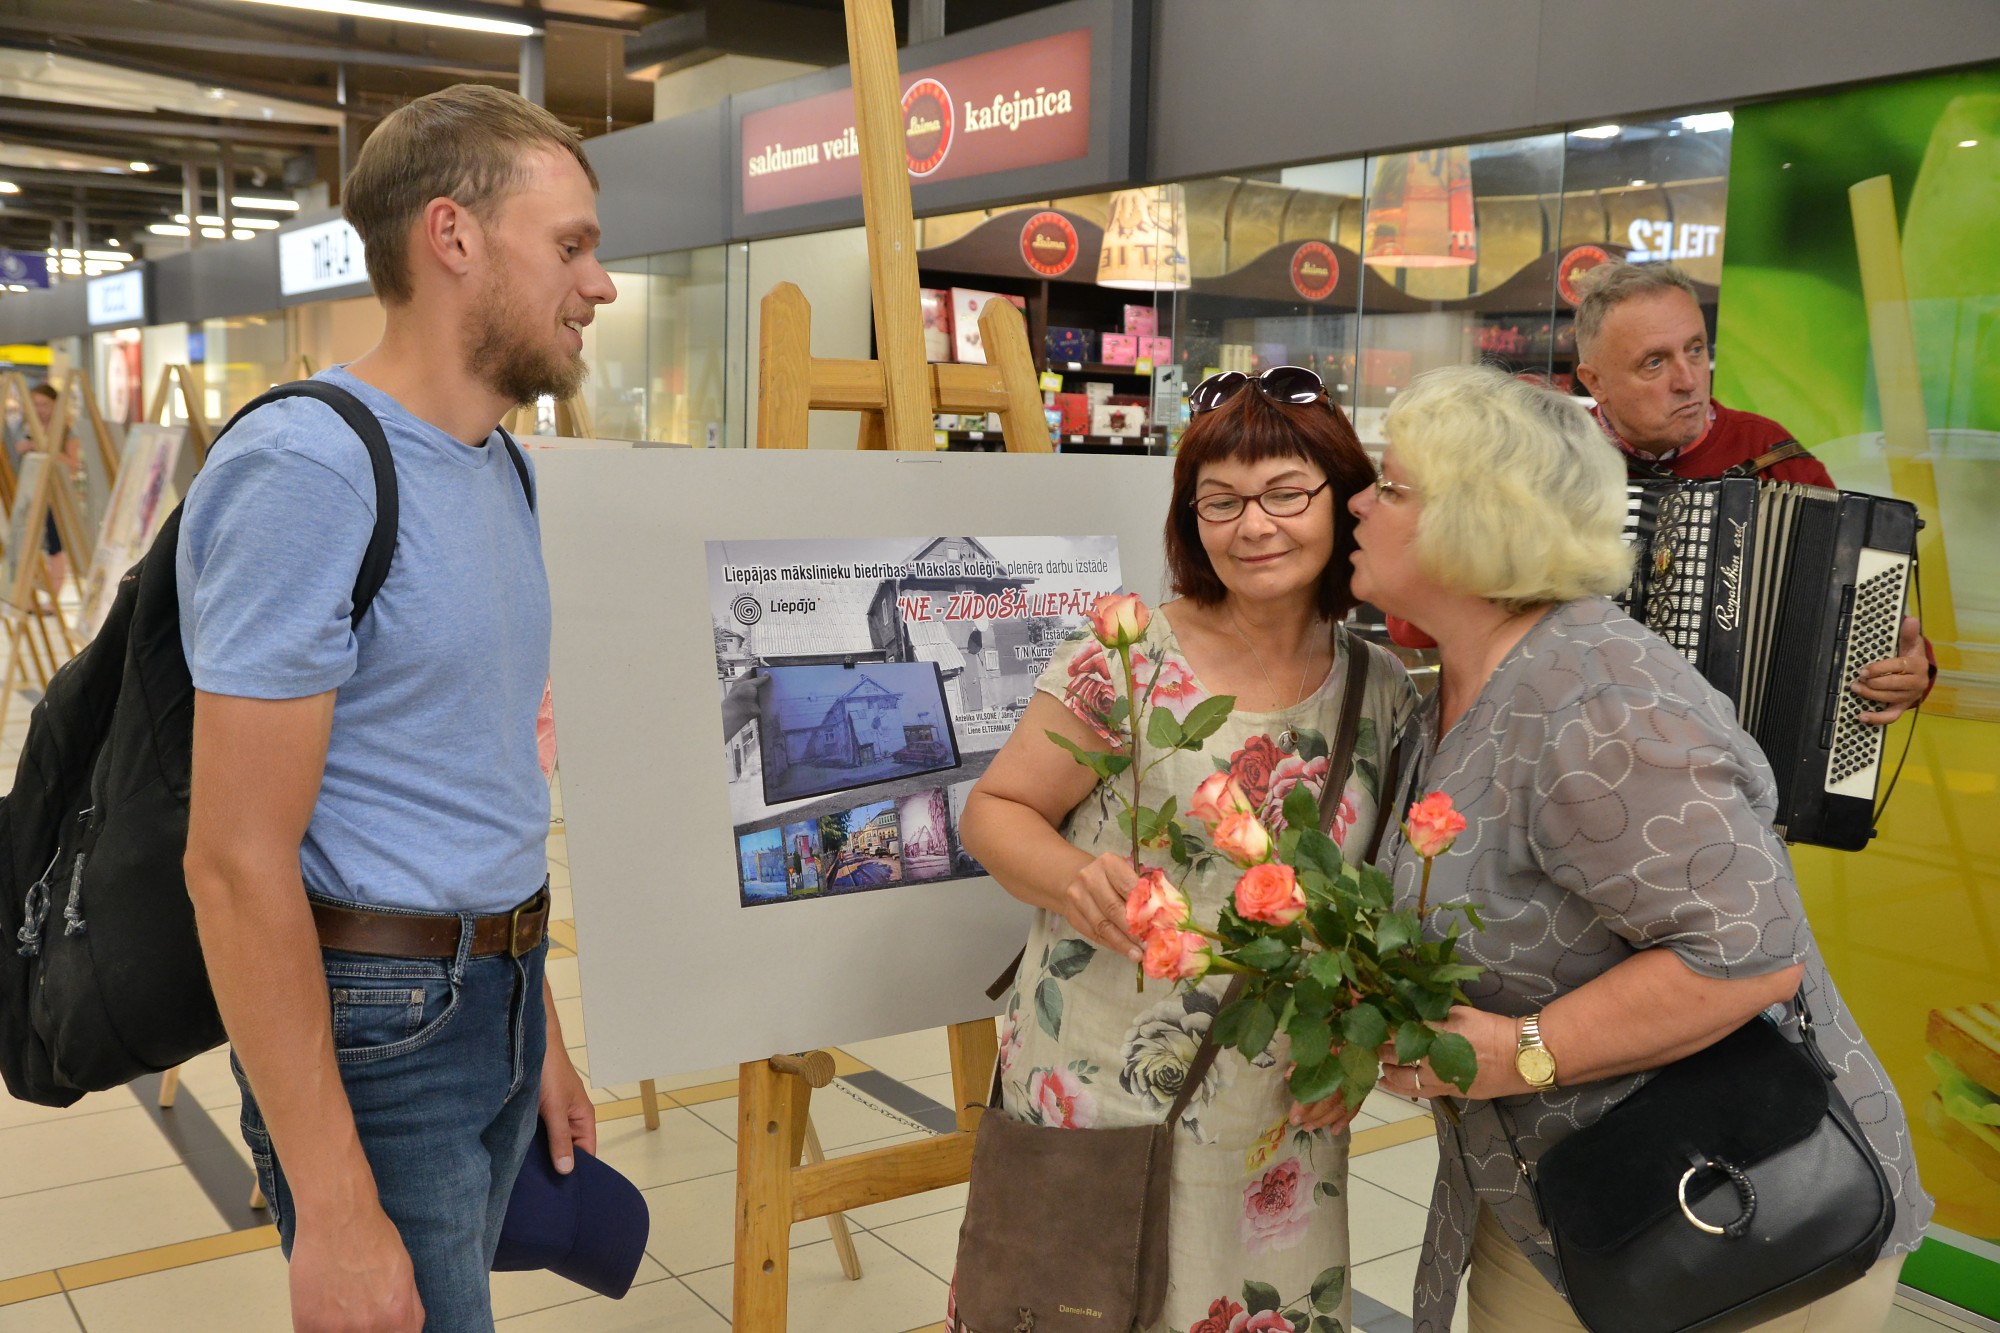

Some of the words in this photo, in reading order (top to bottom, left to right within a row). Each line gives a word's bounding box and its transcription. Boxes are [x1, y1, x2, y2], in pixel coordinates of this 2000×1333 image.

[964, 87, 1072, 132] kafejnīca
[749, 143, 819, 176] saldumu
[724, 565, 777, 585] Liepājas
[781, 564, 851, 581] mākslinieku
[854, 562, 907, 579] biedrības
[1007, 560, 1043, 577] plenēra
[1046, 560, 1073, 574] darbu
[1075, 559, 1108, 573] izstāde
[771, 598, 816, 614] Liepāja
[945, 588, 1028, 621] ZŪDOŠĀ
[1028, 665, 1038, 674] no
